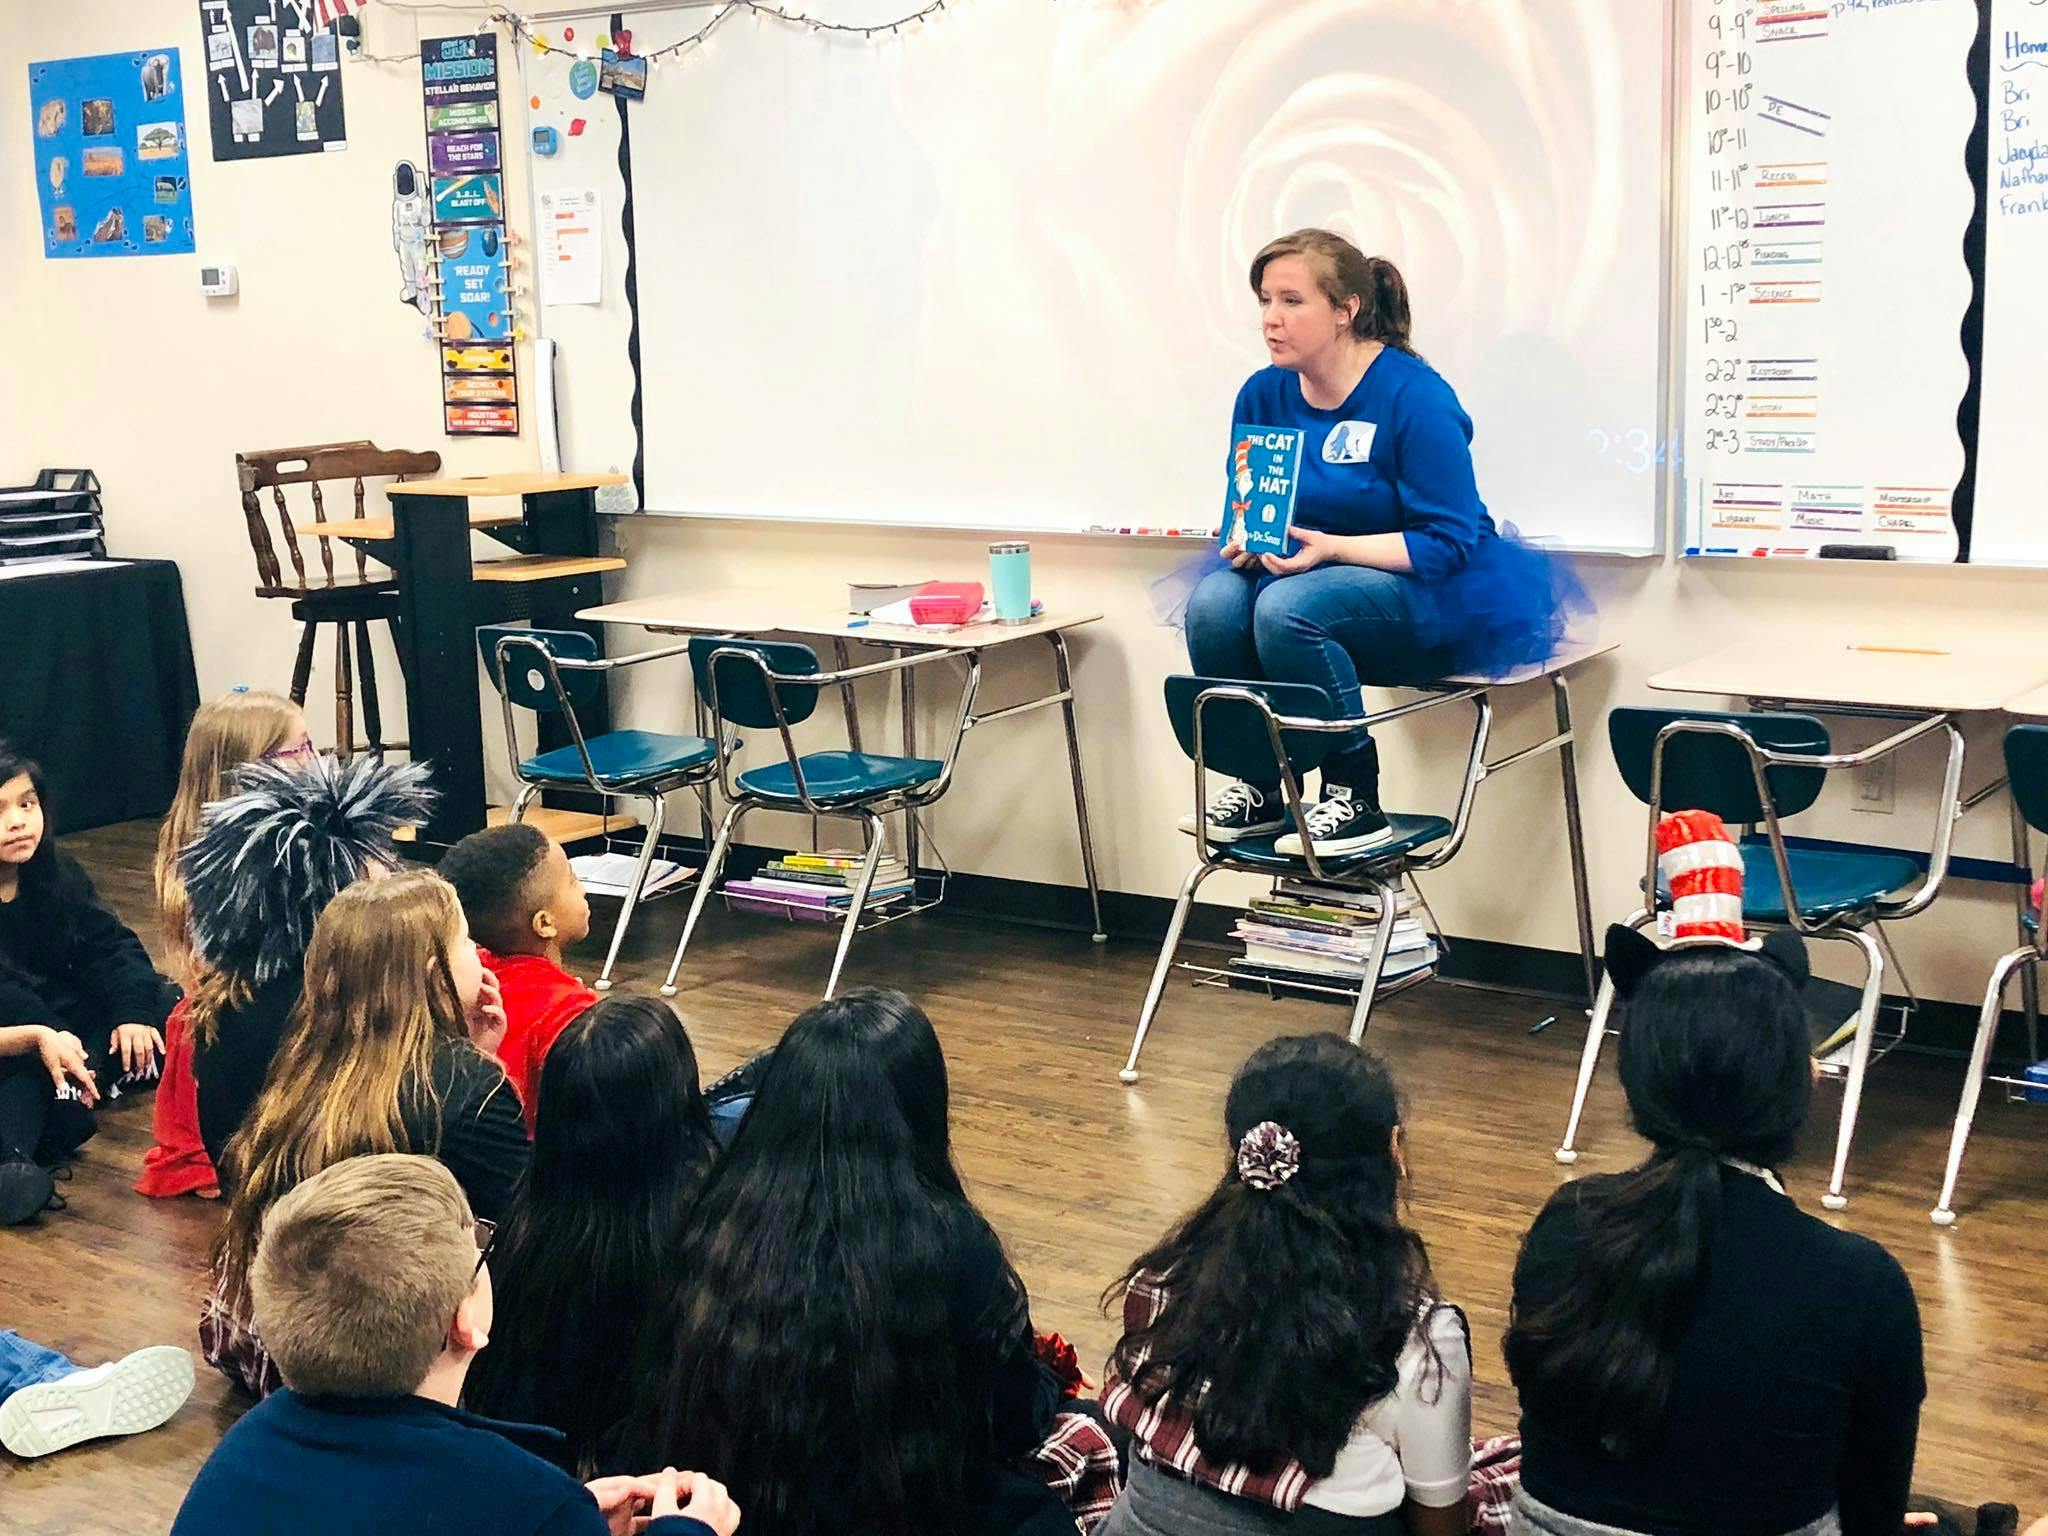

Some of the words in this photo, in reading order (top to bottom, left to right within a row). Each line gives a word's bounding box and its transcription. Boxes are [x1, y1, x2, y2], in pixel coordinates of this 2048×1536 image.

[1762, 25, 1798, 38] SNACK
[424, 58, 495, 80] MISSION:
[425, 84, 460, 95] STELLAR
[460, 81, 496, 93] BEHAVIOR
[2001, 80, 2030, 105] Bri
[2000, 108, 2030, 132] Bri
[448, 153, 461, 161] THE
[463, 152, 483, 160] STARS
[454, 264, 490, 277] READY
[464, 279, 484, 290] SET
[460, 292, 491, 304] SOAR!
[1247, 434, 1264, 446] THE
[1265, 432, 1294, 451] CAT
[1272, 454, 1284, 463] IN
[1268, 465, 1284, 476] THE
[1258, 475, 1290, 496] HAT
